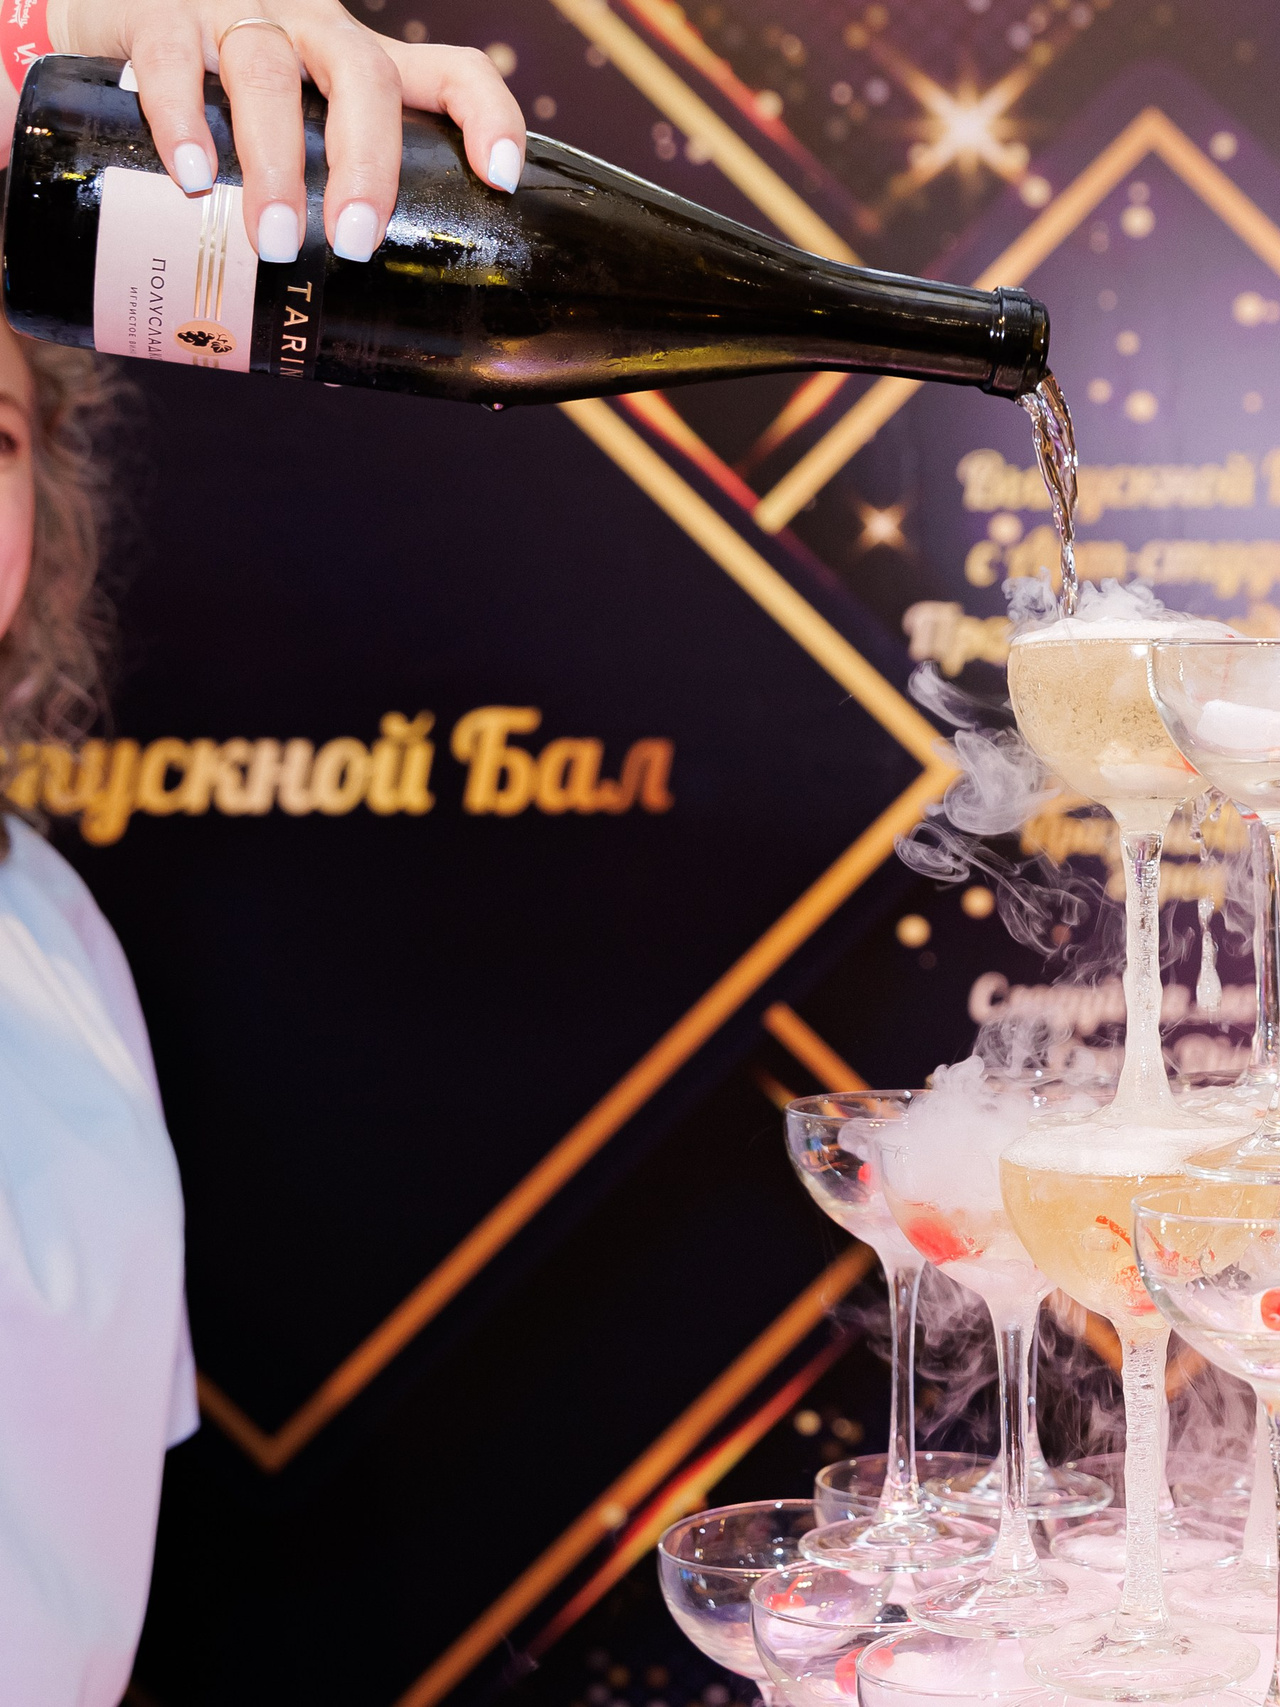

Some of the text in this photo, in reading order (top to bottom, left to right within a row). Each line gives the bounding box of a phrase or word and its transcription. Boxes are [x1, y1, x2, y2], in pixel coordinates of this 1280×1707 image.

[128, 286, 138, 338] ИГРИСТОЕ
[0, 704, 674, 845] пускной Бал
